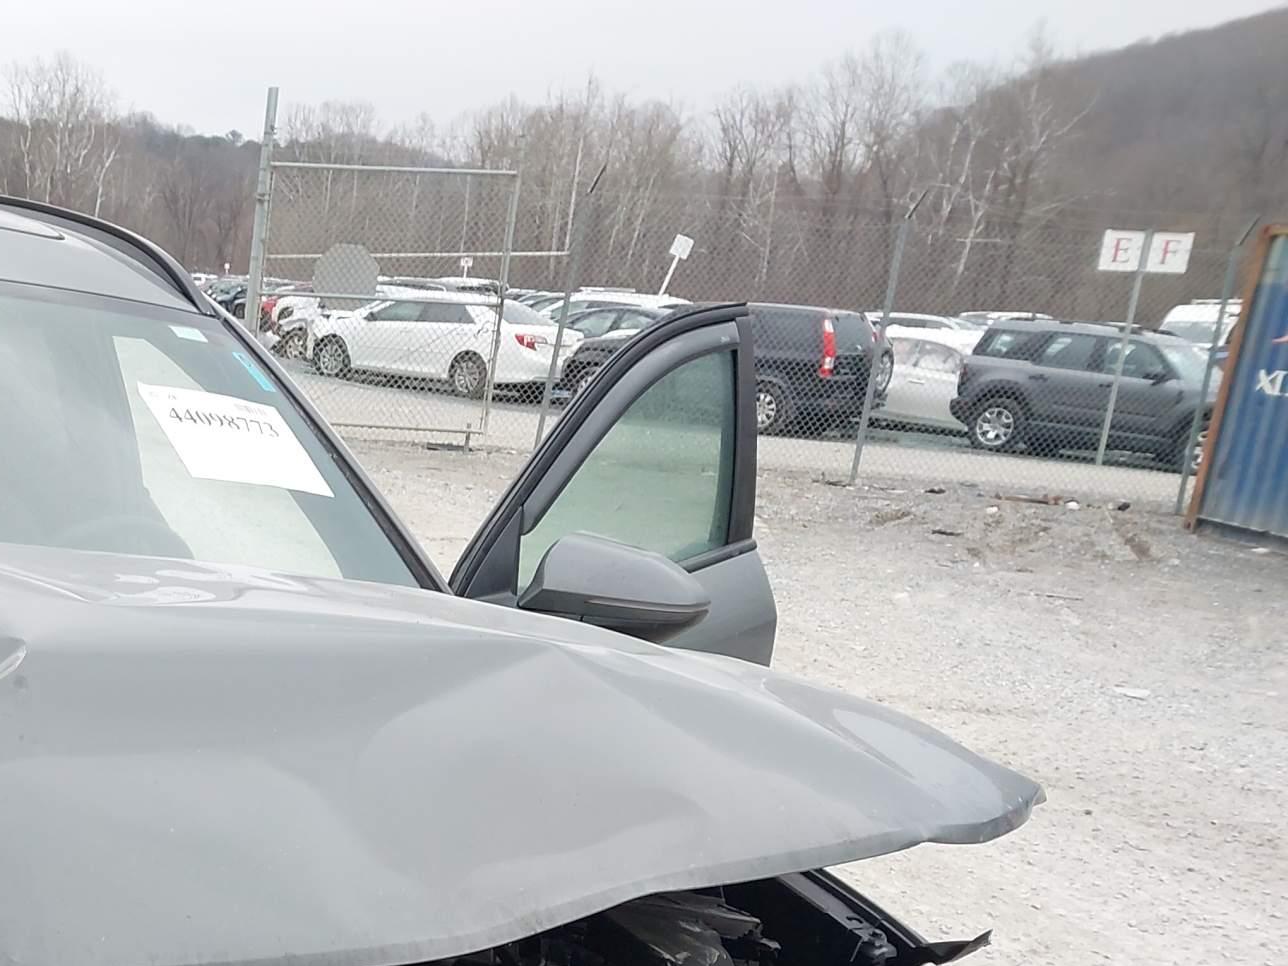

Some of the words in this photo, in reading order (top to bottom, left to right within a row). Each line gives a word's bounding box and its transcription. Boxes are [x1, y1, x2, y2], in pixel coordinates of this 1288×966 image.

[1111, 237, 1133, 263] E
[1159, 239, 1182, 265] F
[168, 407, 280, 437] 44098773
